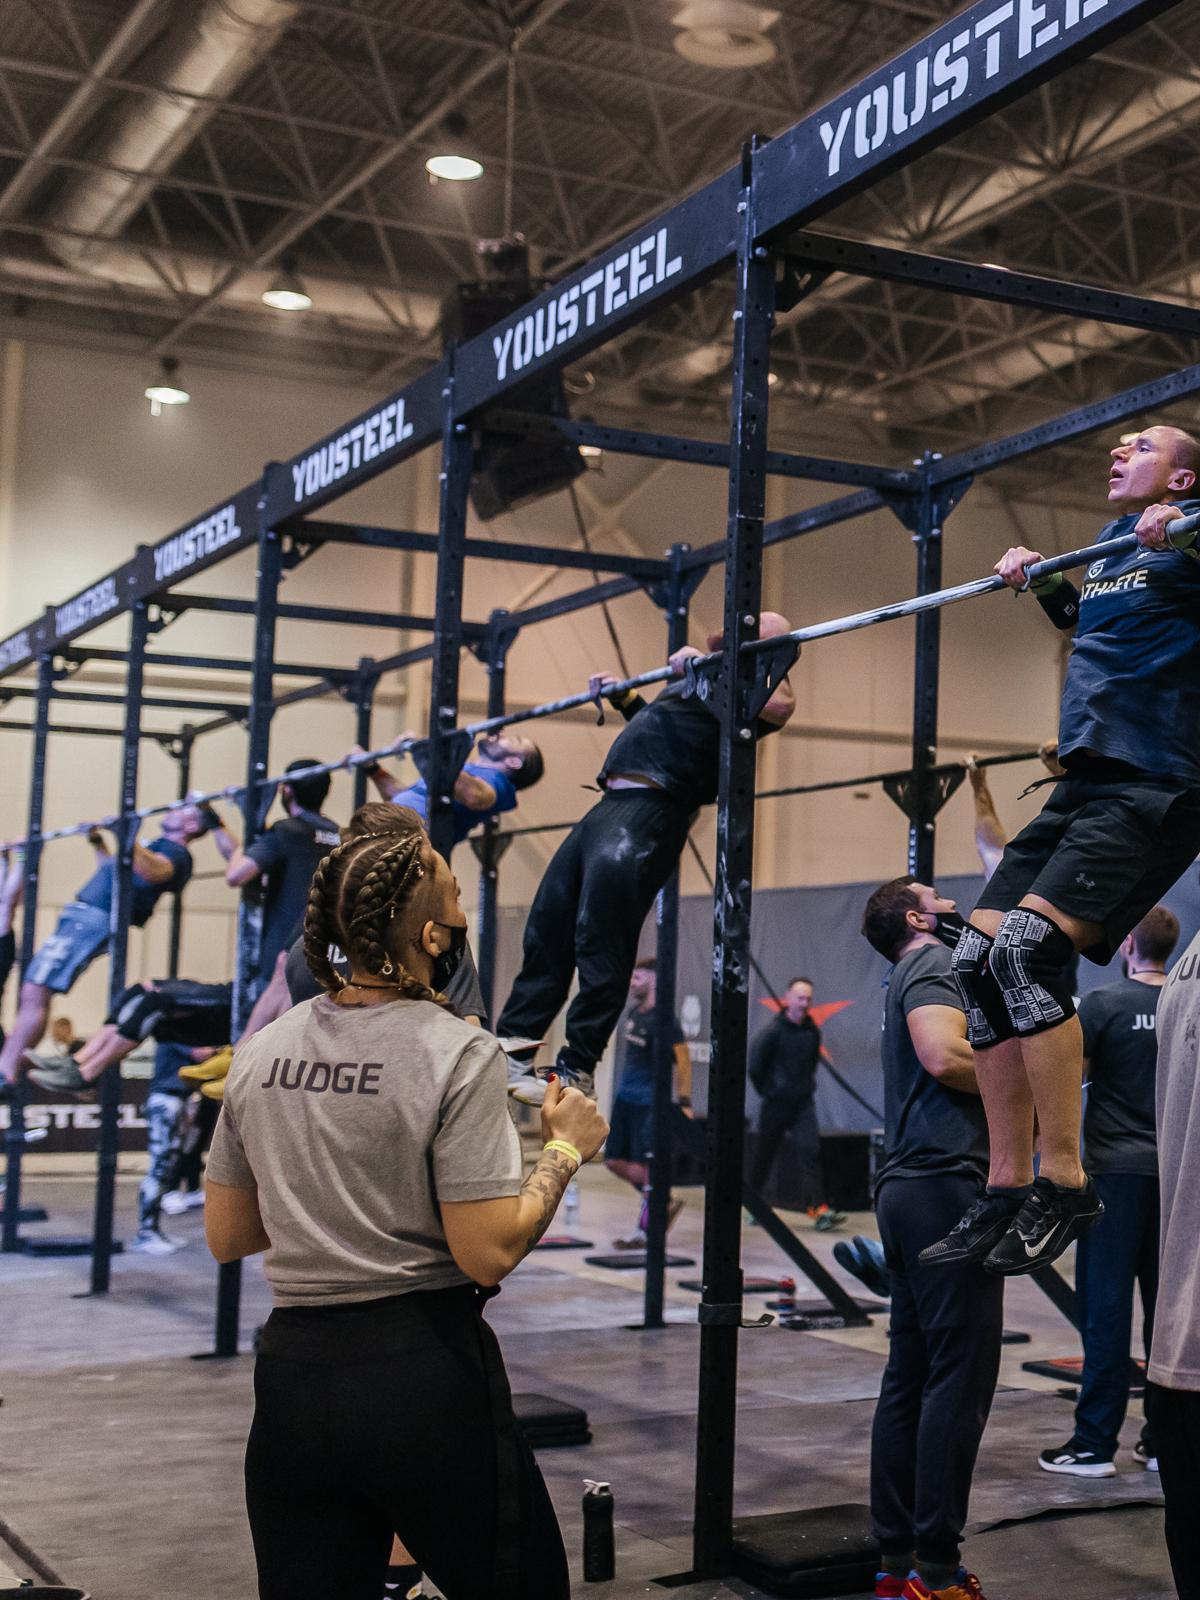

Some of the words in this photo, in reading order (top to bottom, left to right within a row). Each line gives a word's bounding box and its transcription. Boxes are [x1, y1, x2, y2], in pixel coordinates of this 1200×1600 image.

[493, 227, 682, 381] YOUSTEEL
[292, 398, 414, 502] YOUSTEEL
[154, 504, 241, 581] YOUSTEEL
[261, 1057, 385, 1095] JUDGE
